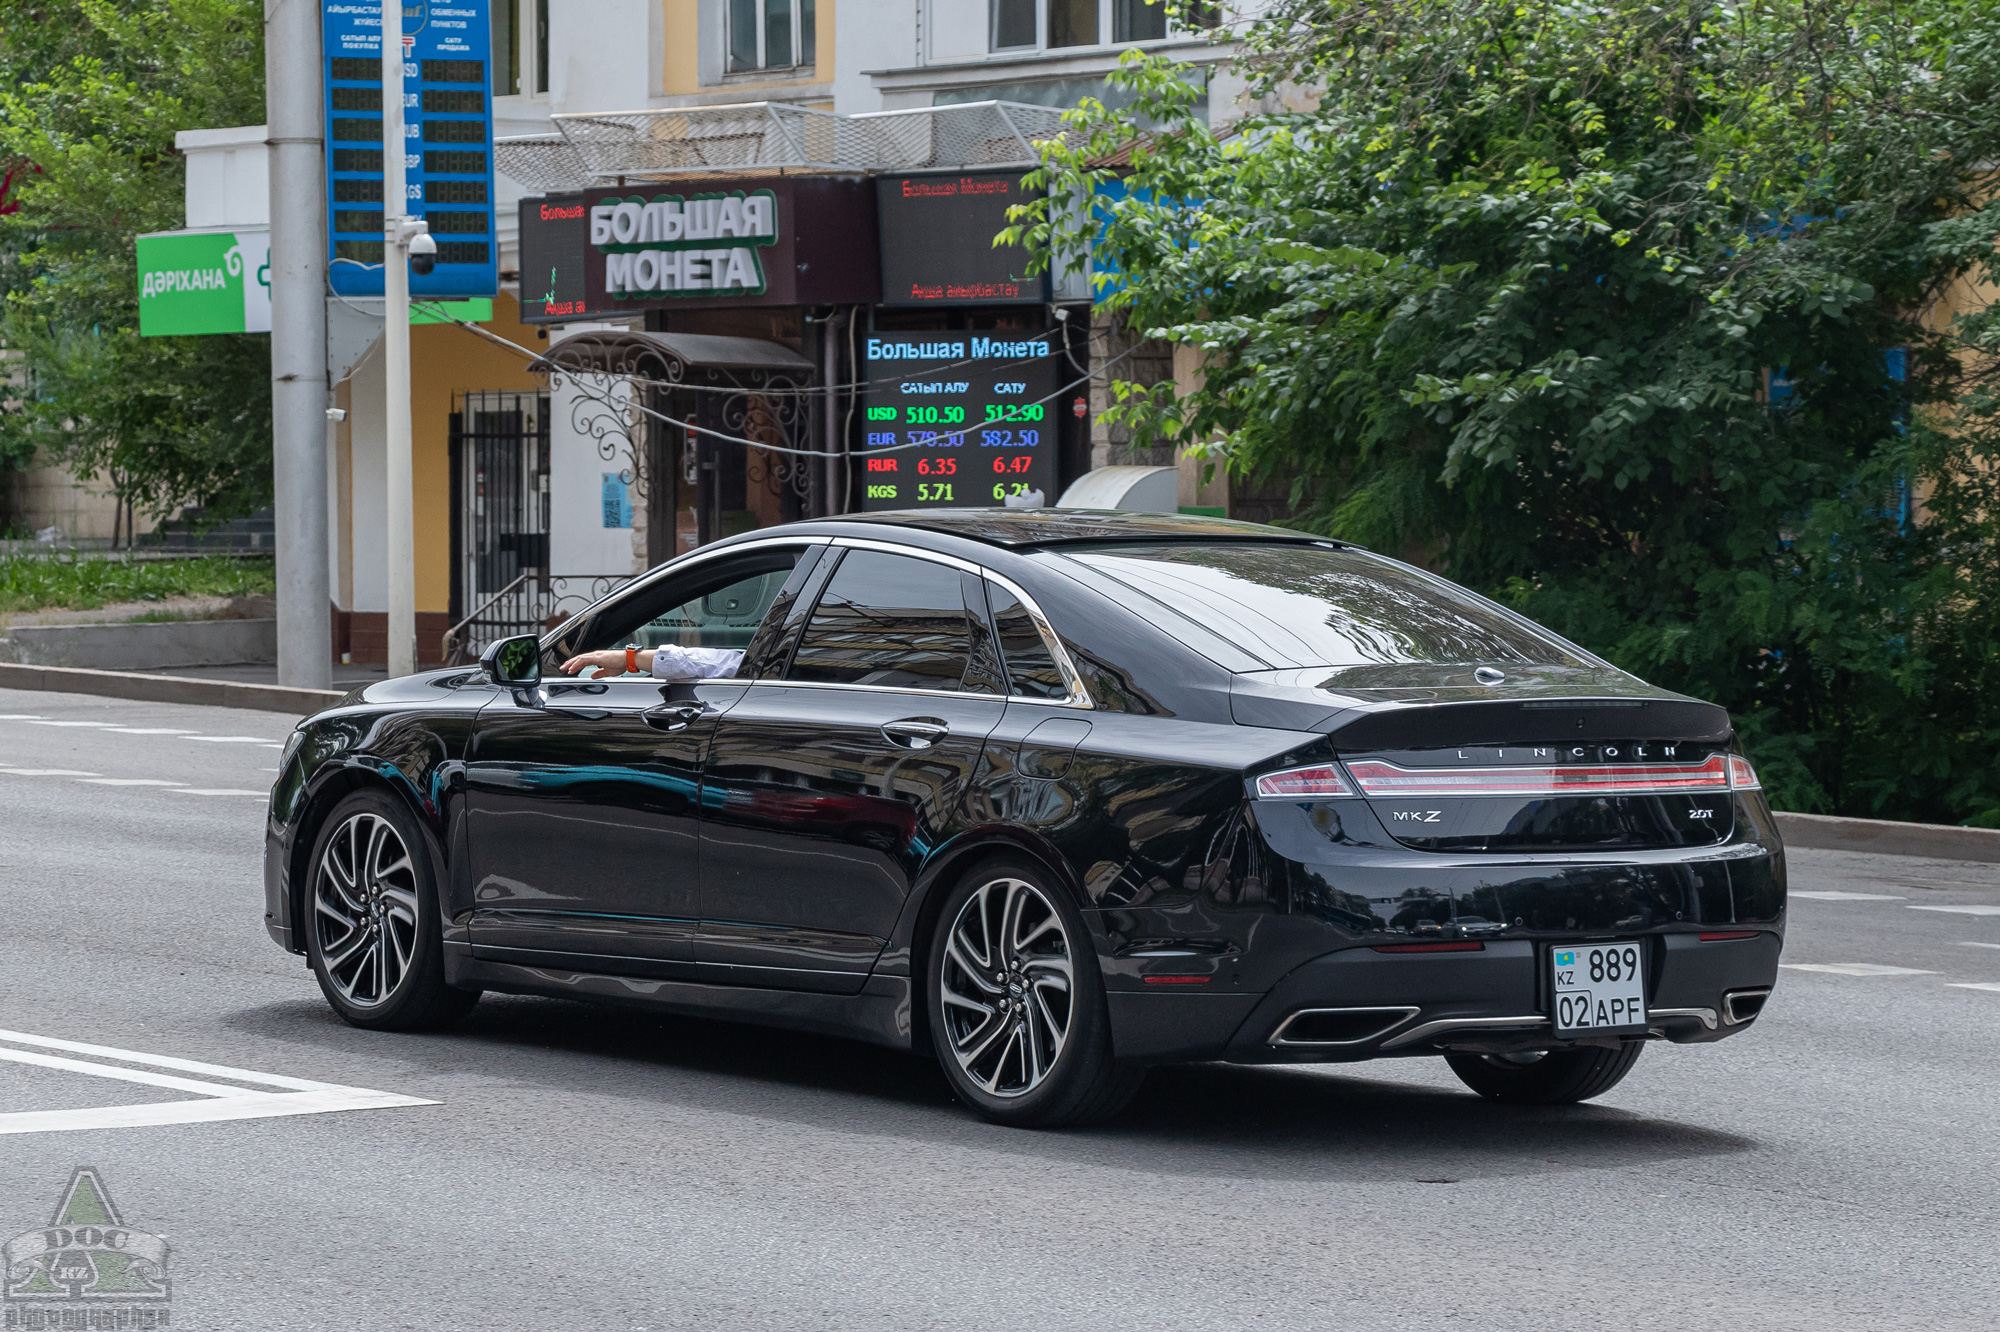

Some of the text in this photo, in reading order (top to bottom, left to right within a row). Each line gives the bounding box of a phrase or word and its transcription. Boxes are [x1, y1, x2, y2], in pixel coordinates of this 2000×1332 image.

[430, 8, 476, 17] ОБМЕННЫХ
[430, 20, 467, 28] ПУНКТОВ
[403, 63, 418, 77] SD
[590, 195, 773, 245] БОЛЬШАЯ
[606, 247, 760, 293] МОНЕТА
[142, 268, 226, 298] ДӘРІХАНА
[867, 337, 1050, 360] Большая Монета
[900, 382, 1027, 394] САТЫП АЛУ САТУ
[867, 404, 1044, 424] USD 510.50 512.90
[867, 430, 1039, 447] EUR 578.50 582.50
[867, 456, 1032, 475] RUR 6.35 6.47
[867, 485, 898, 498] KGS
[917, 483, 954, 501] 5.71
[1458, 747, 1675, 759] LINCOLN
[1393, 810, 1442, 822] MKZ
[1589, 948, 1637, 983] 889
[1557, 971, 1574, 985] KZ
